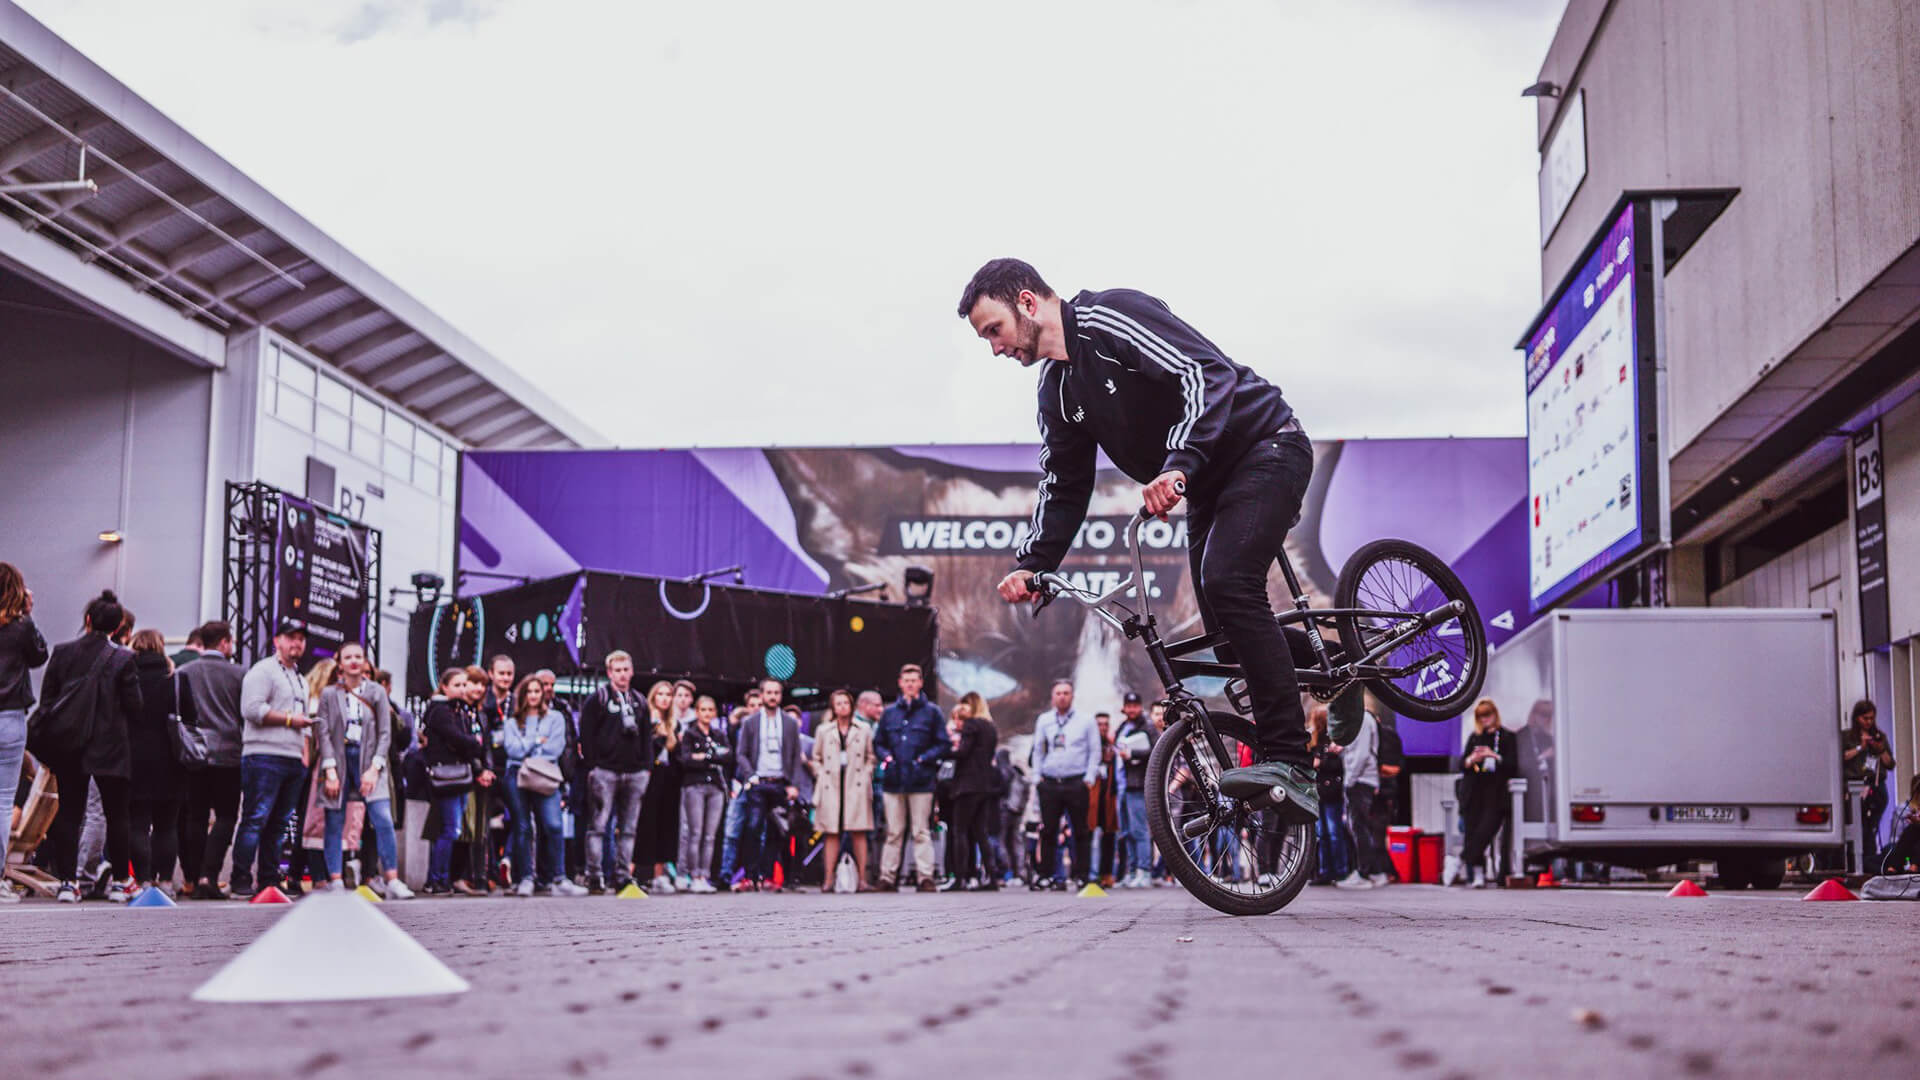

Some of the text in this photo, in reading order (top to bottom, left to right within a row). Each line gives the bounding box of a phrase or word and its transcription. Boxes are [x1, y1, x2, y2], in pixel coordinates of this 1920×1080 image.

[1859, 450, 1880, 497] B3
[341, 486, 365, 521] B7
[900, 521, 1034, 549] WELCO
